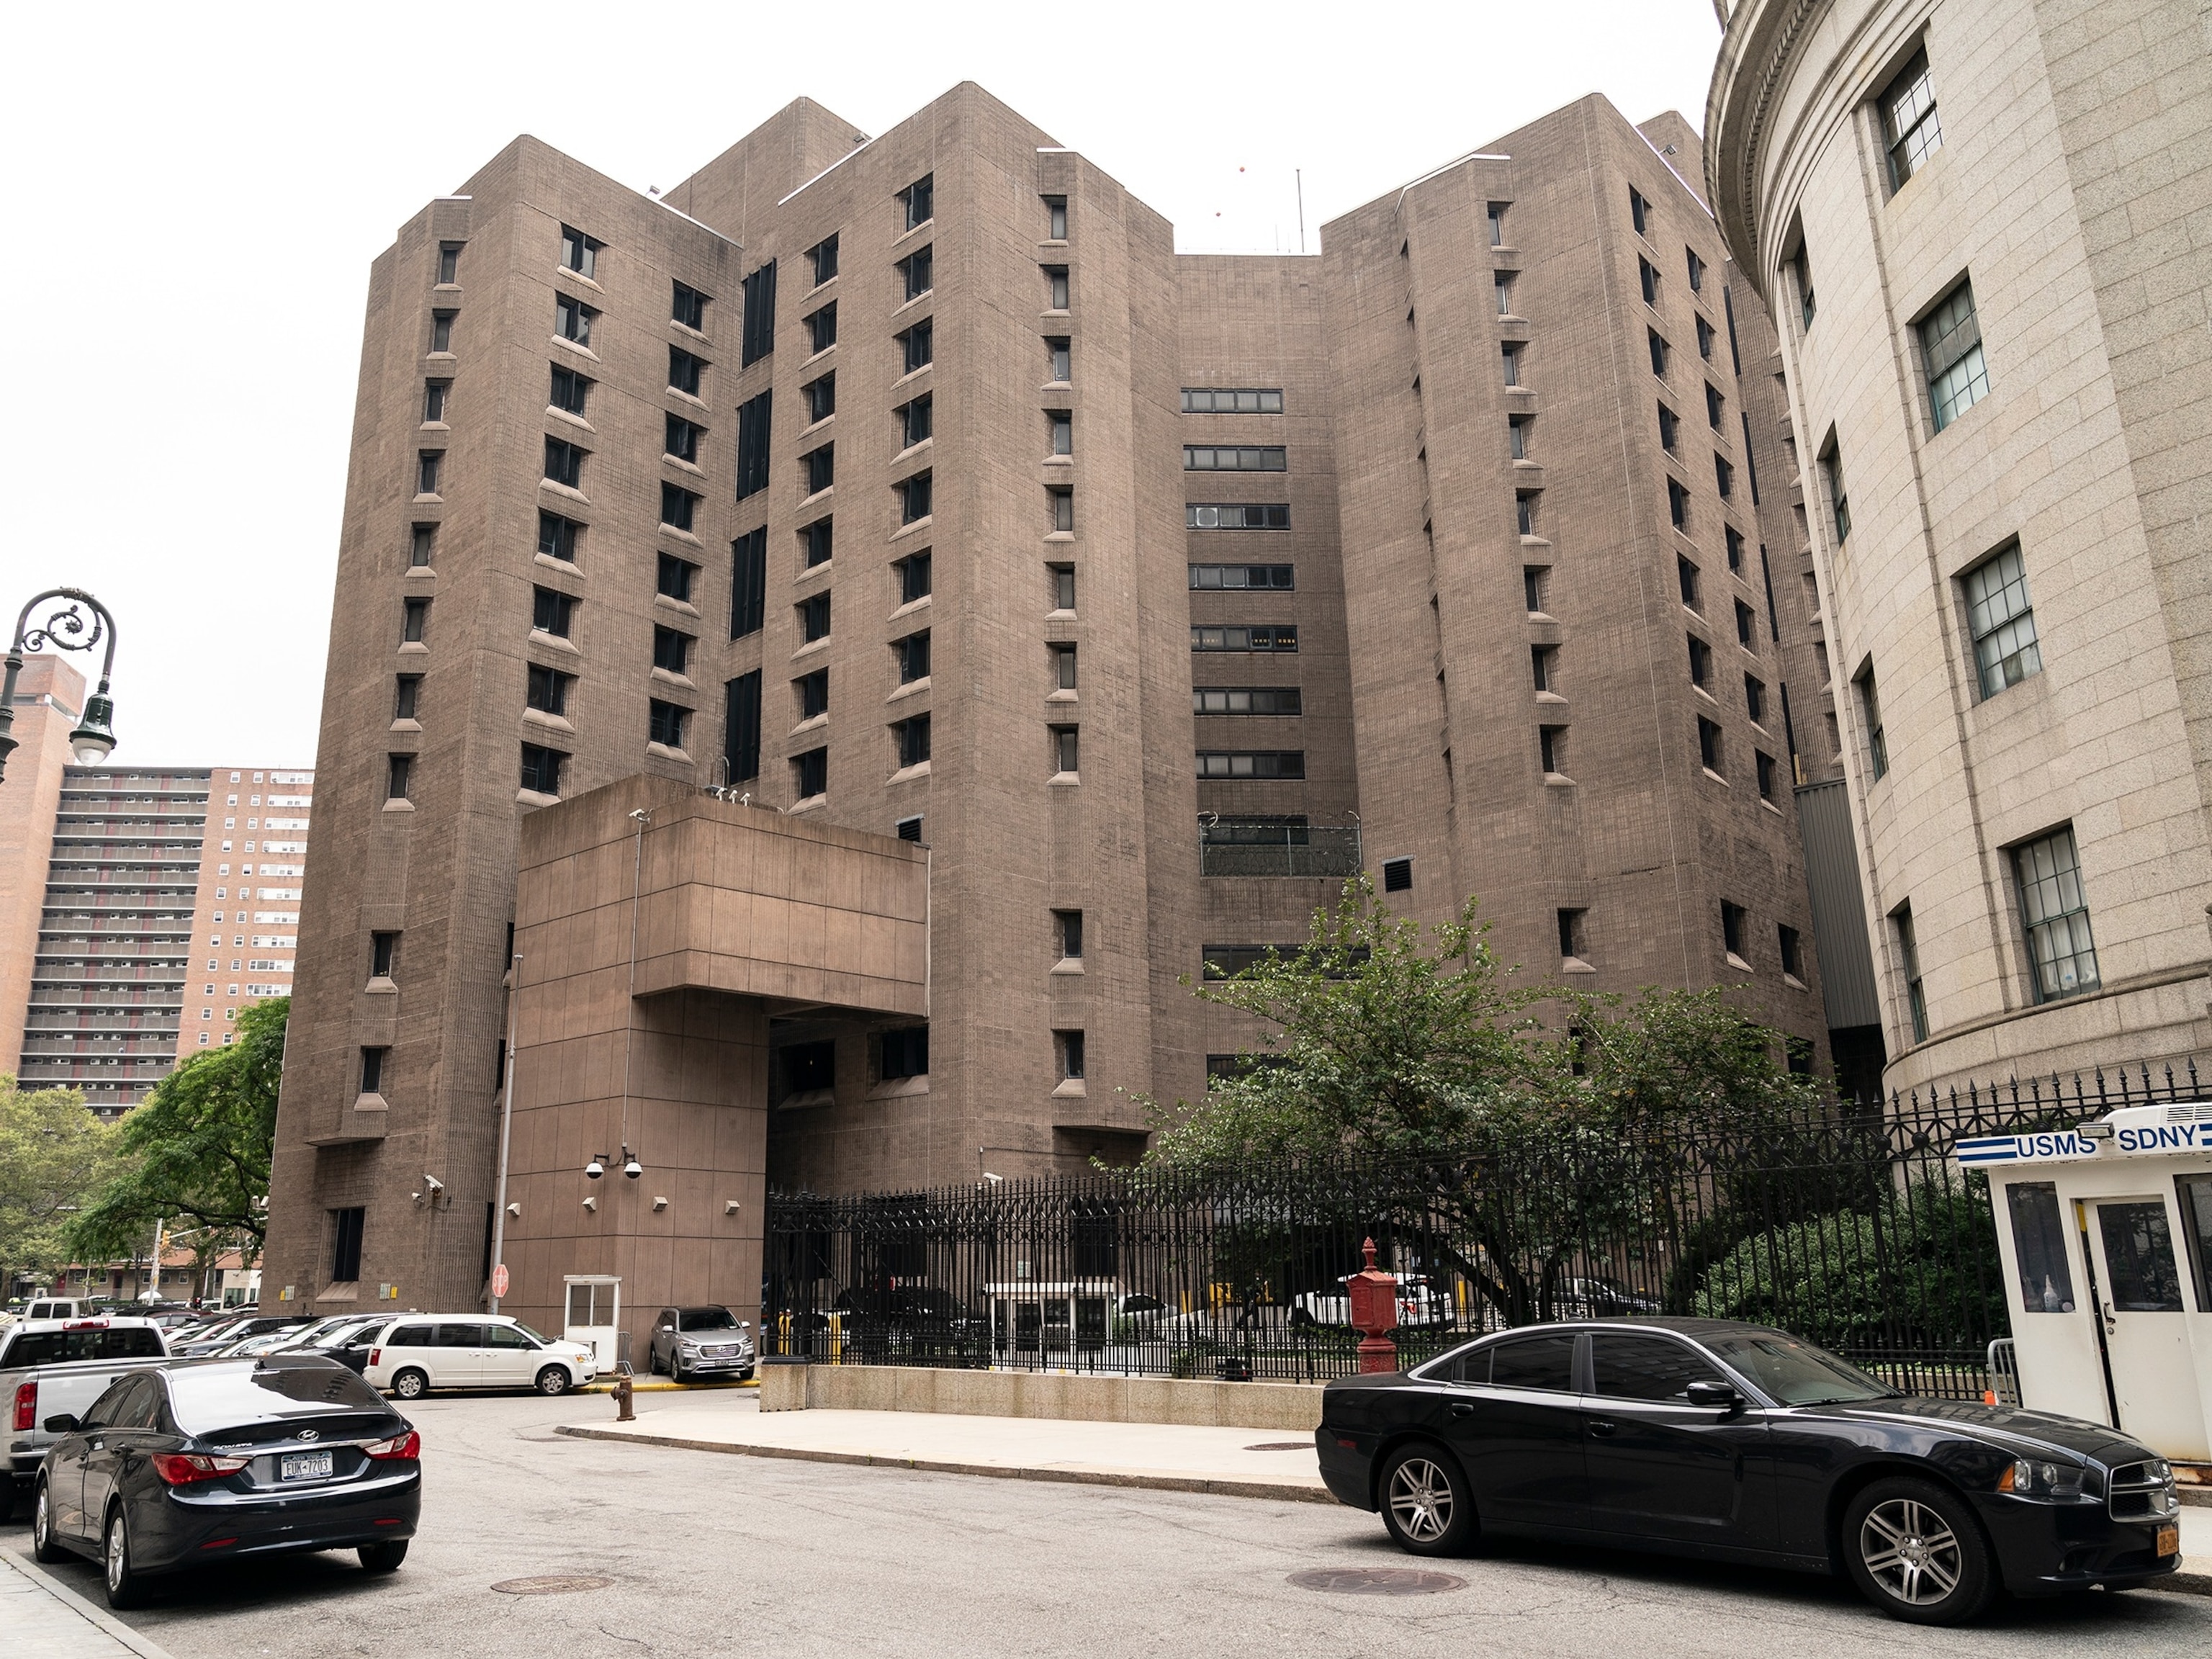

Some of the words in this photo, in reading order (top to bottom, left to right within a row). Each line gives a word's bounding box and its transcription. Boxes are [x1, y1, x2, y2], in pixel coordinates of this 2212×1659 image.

[2017, 1134, 2096, 1158] USMS
[2118, 1125, 2196, 1151] SDNY
[494, 1274, 508, 1287] STOP
